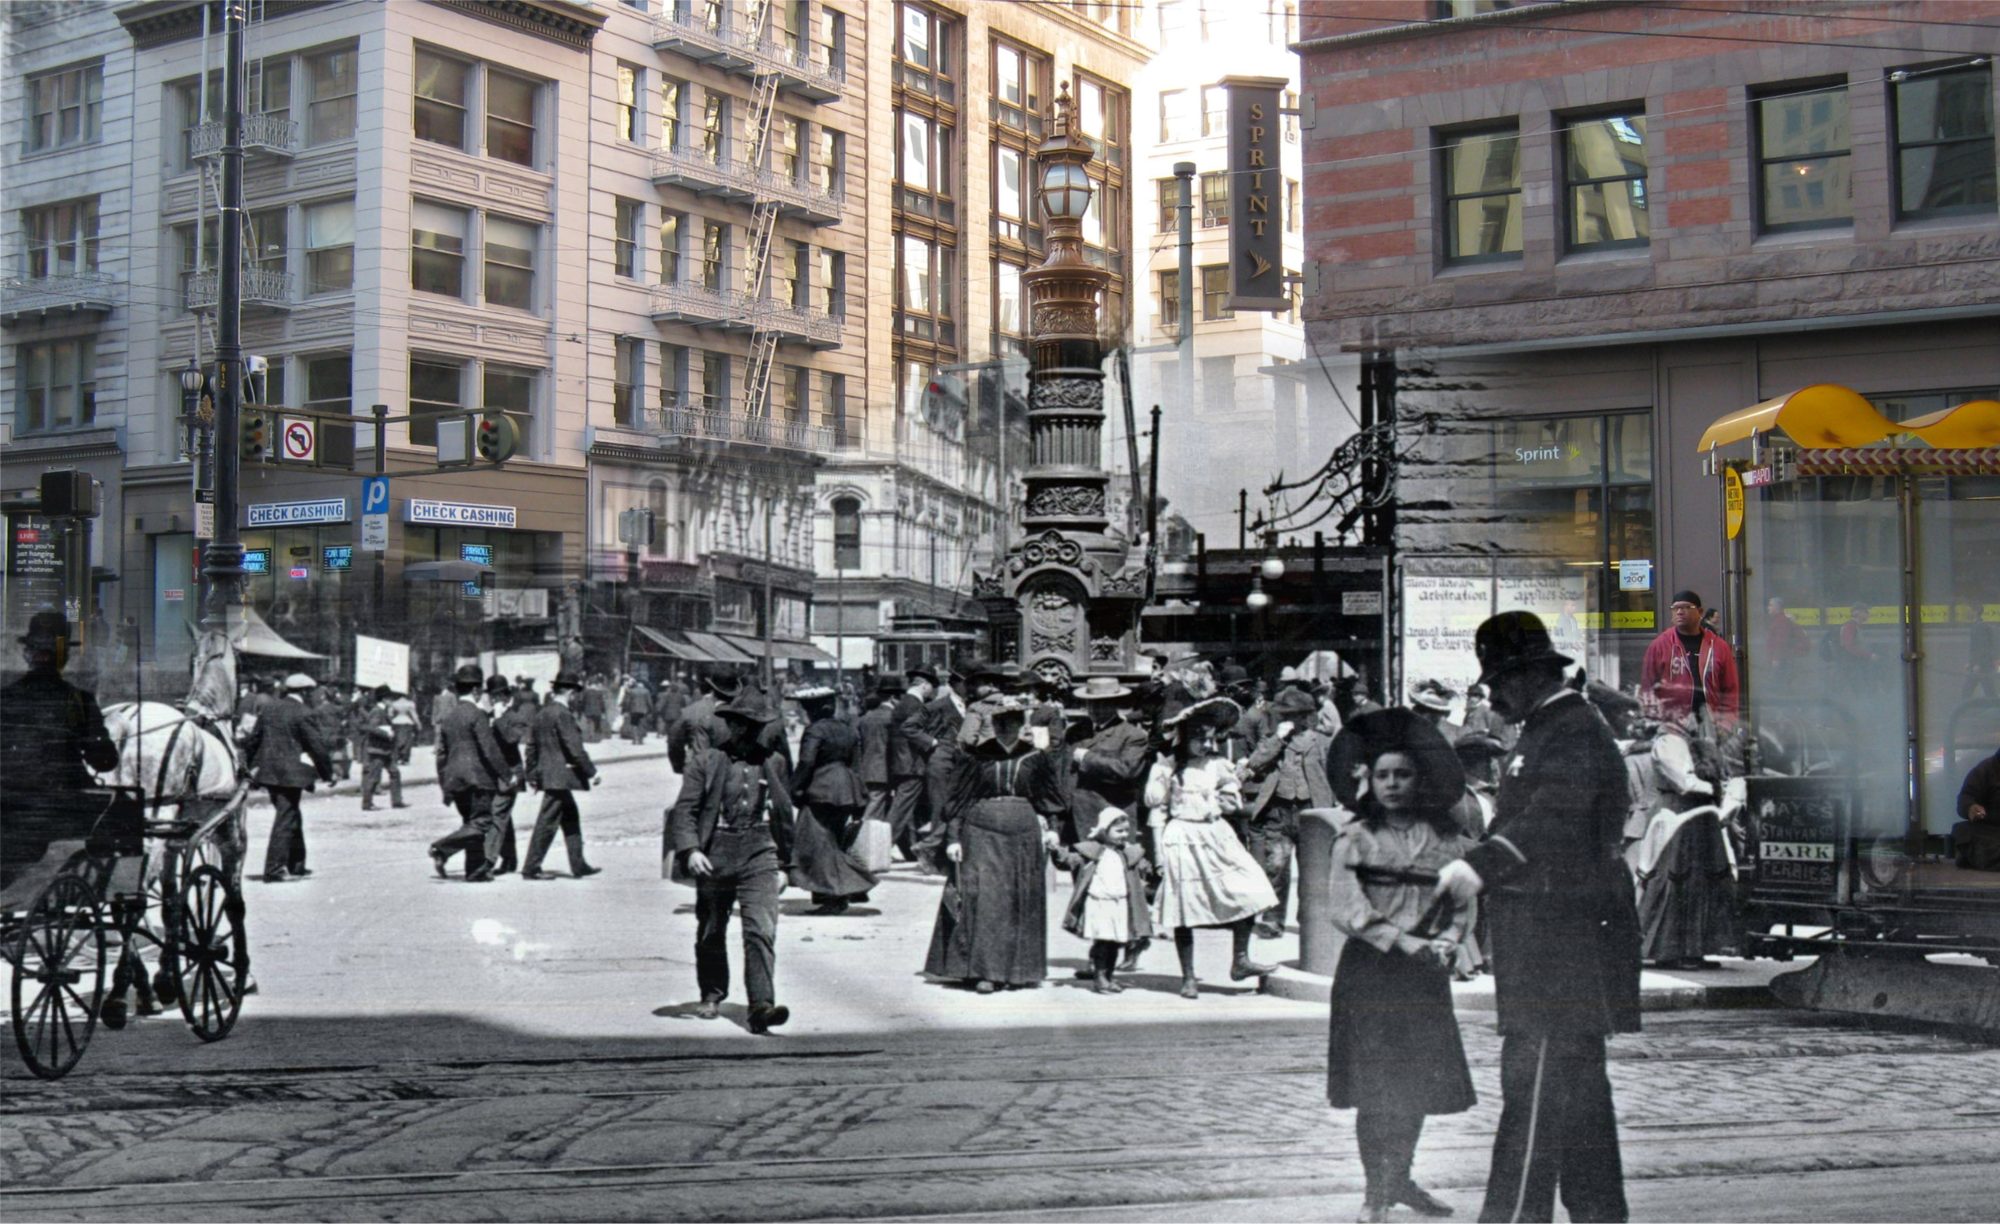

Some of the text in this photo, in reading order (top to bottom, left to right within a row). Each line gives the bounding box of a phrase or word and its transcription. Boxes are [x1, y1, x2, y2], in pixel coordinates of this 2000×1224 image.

[1249, 103, 1268, 236] SPRINT
[1515, 446, 1560, 464] Sprint
[249, 504, 343, 522] CHECK CASHING
[413, 505, 515, 523] CHECK CASHING
[1765, 845, 1831, 858] PARK
